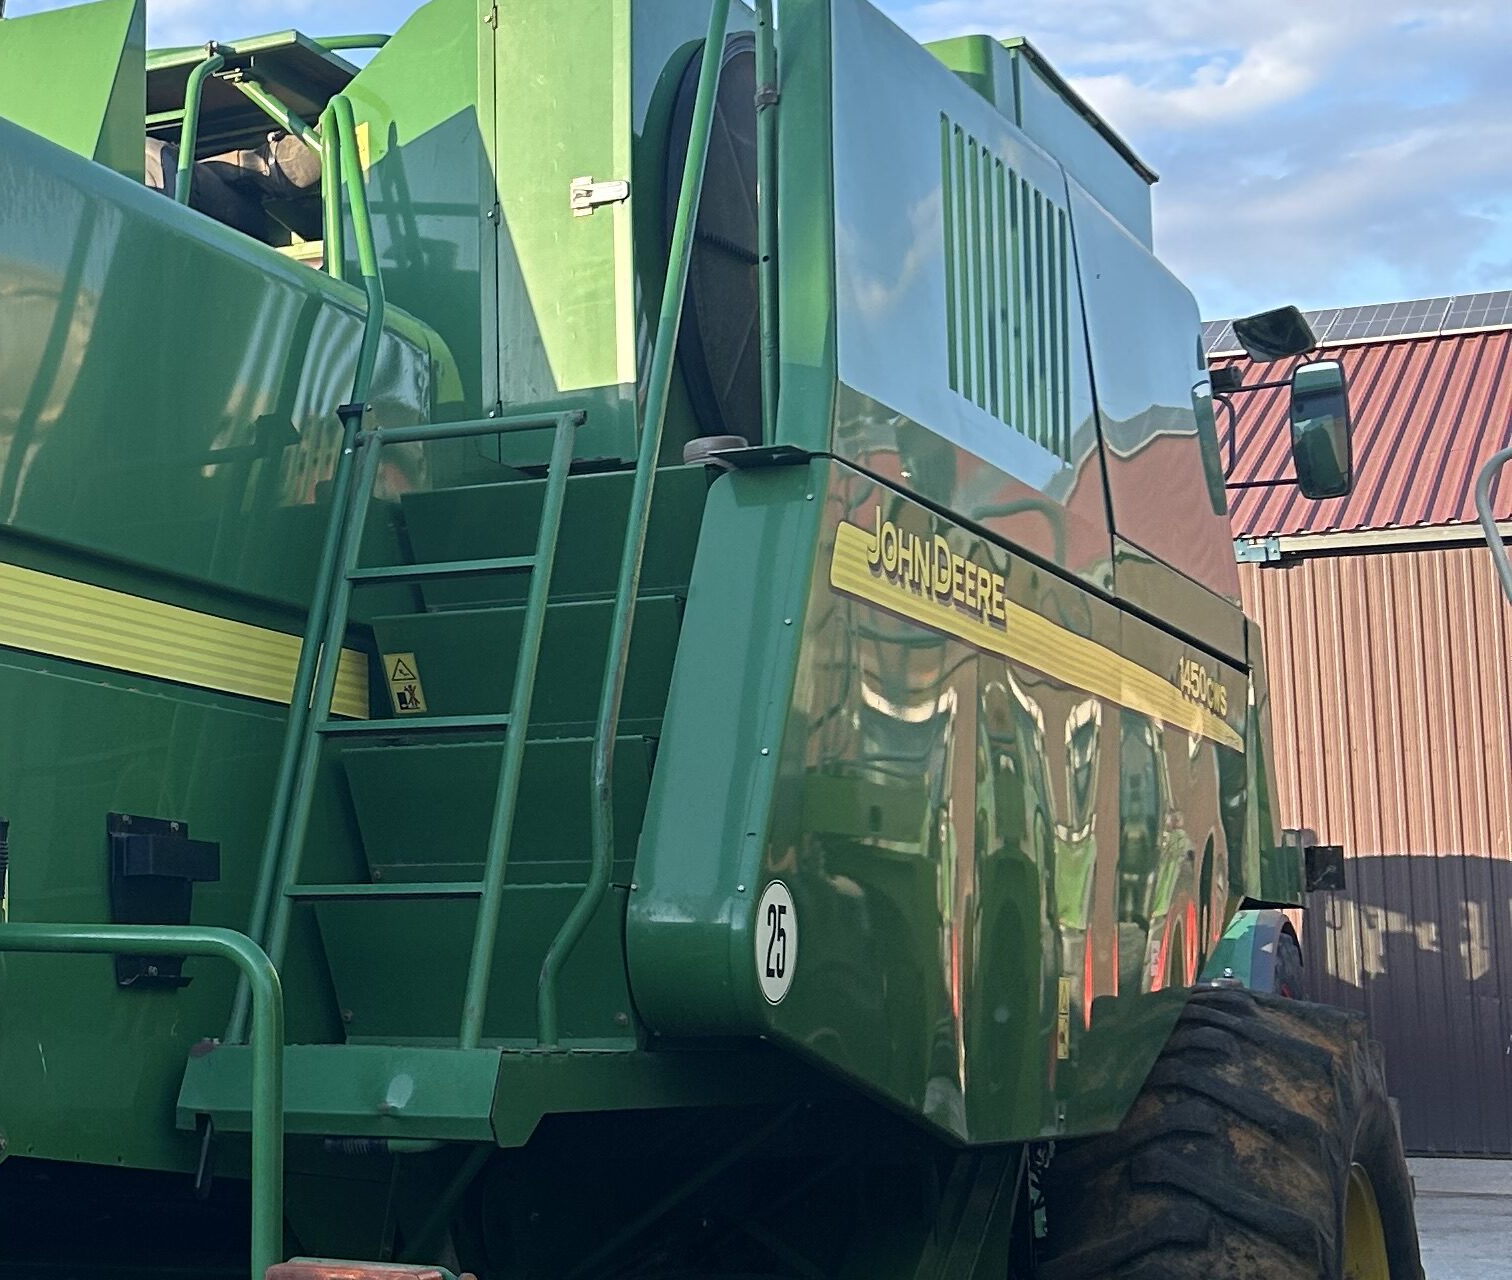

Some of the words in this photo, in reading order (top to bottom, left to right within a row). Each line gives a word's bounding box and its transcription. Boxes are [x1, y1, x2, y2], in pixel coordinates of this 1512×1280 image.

[867, 505, 930, 588] JOHN
[934, 534, 1006, 621] DEERE
[766, 904, 787, 978] 25
